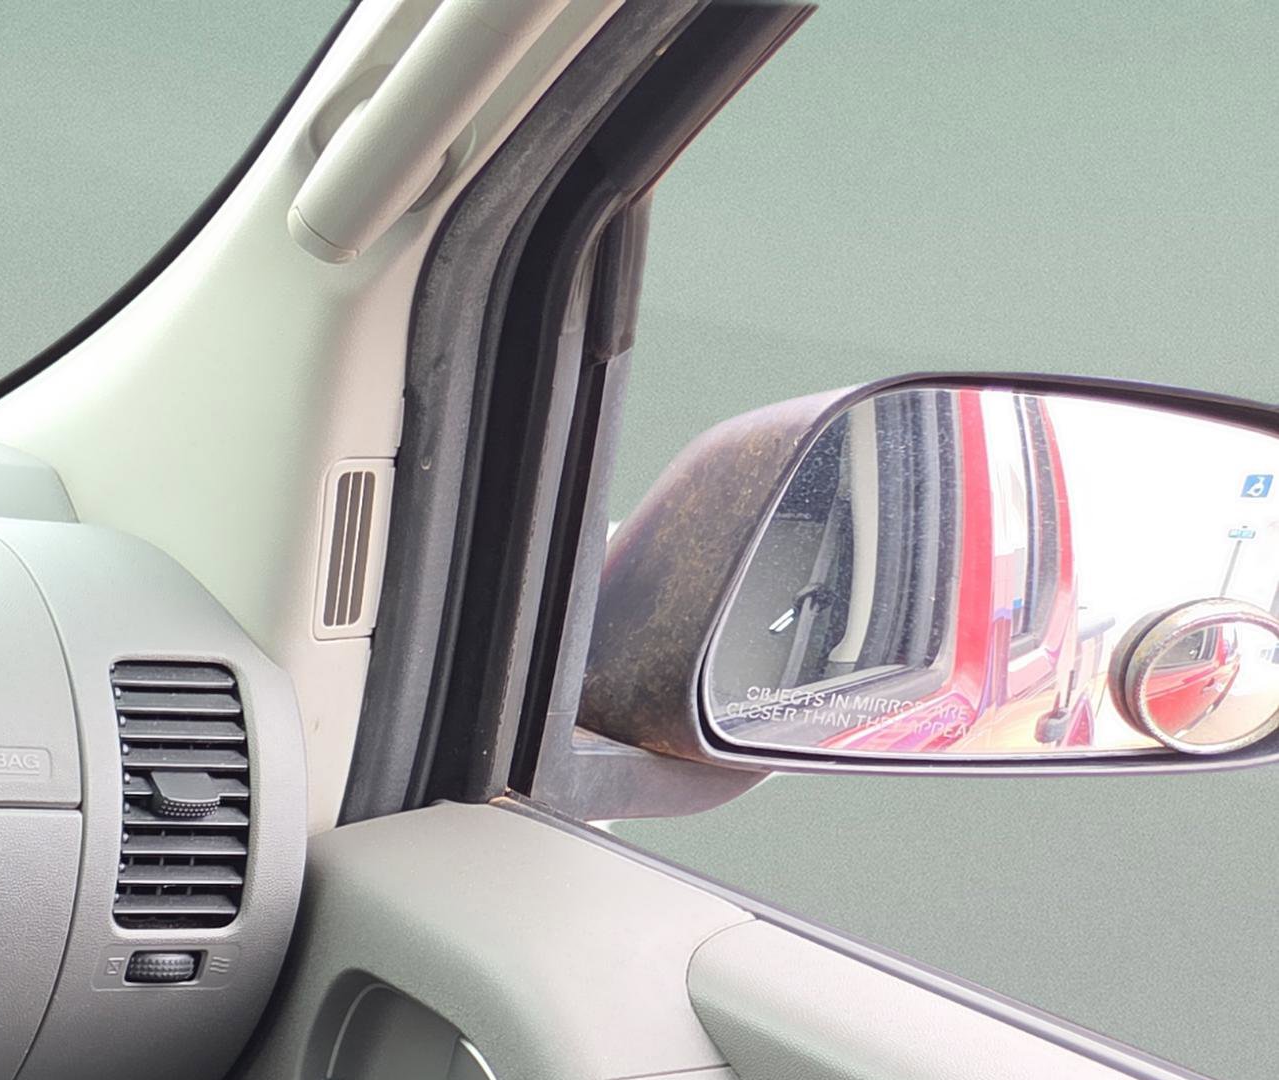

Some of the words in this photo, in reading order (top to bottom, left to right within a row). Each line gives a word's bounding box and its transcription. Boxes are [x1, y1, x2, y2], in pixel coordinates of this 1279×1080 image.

[746, 686, 825, 707] OBJECTS
[829, 693, 849, 709] IN
[726, 702, 797, 722] CLOSER
[803, 709, 851, 728] THAN
